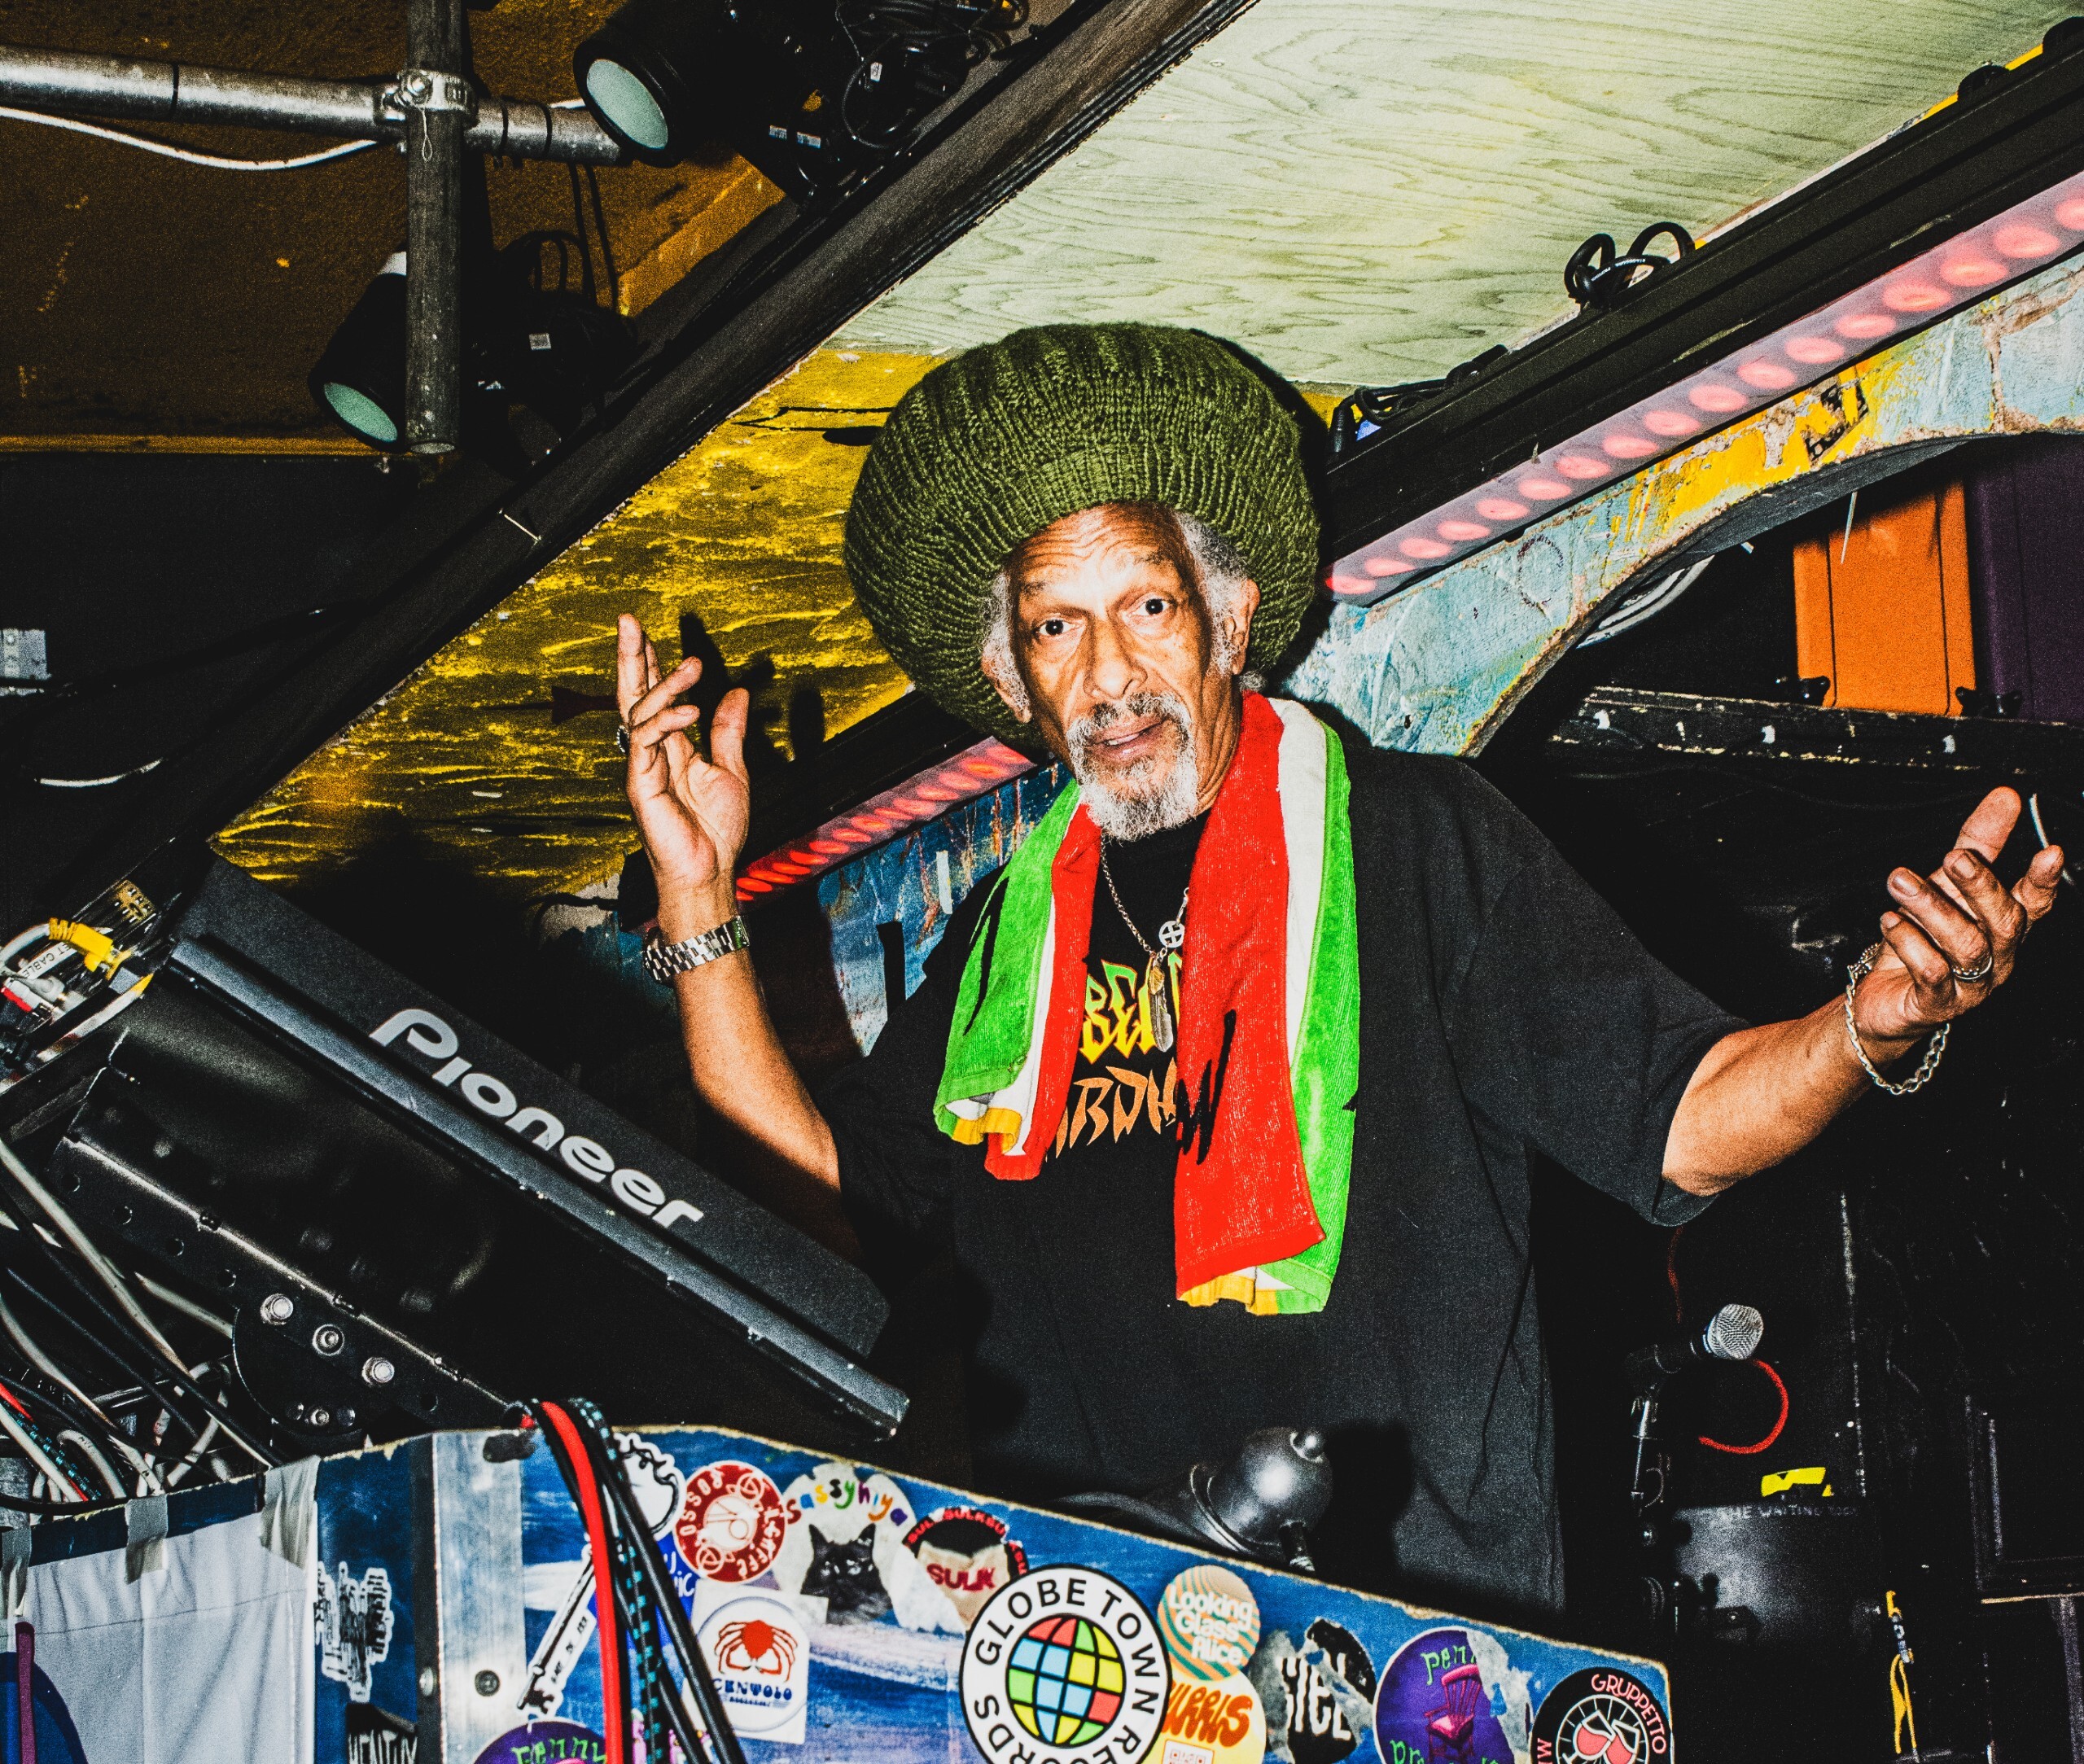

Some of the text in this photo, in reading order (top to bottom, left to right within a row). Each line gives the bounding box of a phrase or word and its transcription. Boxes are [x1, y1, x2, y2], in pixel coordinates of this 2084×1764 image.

[23, 953, 55, 978] CABLE
[368, 1009, 704, 1228] Pioneer
[926, 1562, 996, 1592] SULK
[1170, 1584, 1254, 1631] Looking
[1175, 1610, 1241, 1643] Glass
[975, 1577, 1088, 1666] GLOBE
[1100, 1588, 1161, 1715] TOWN
[1192, 1635, 1243, 1666] Alice
[1421, 1644, 1478, 1686] pen
[1591, 1673, 1668, 1755] GRUPPETTO
